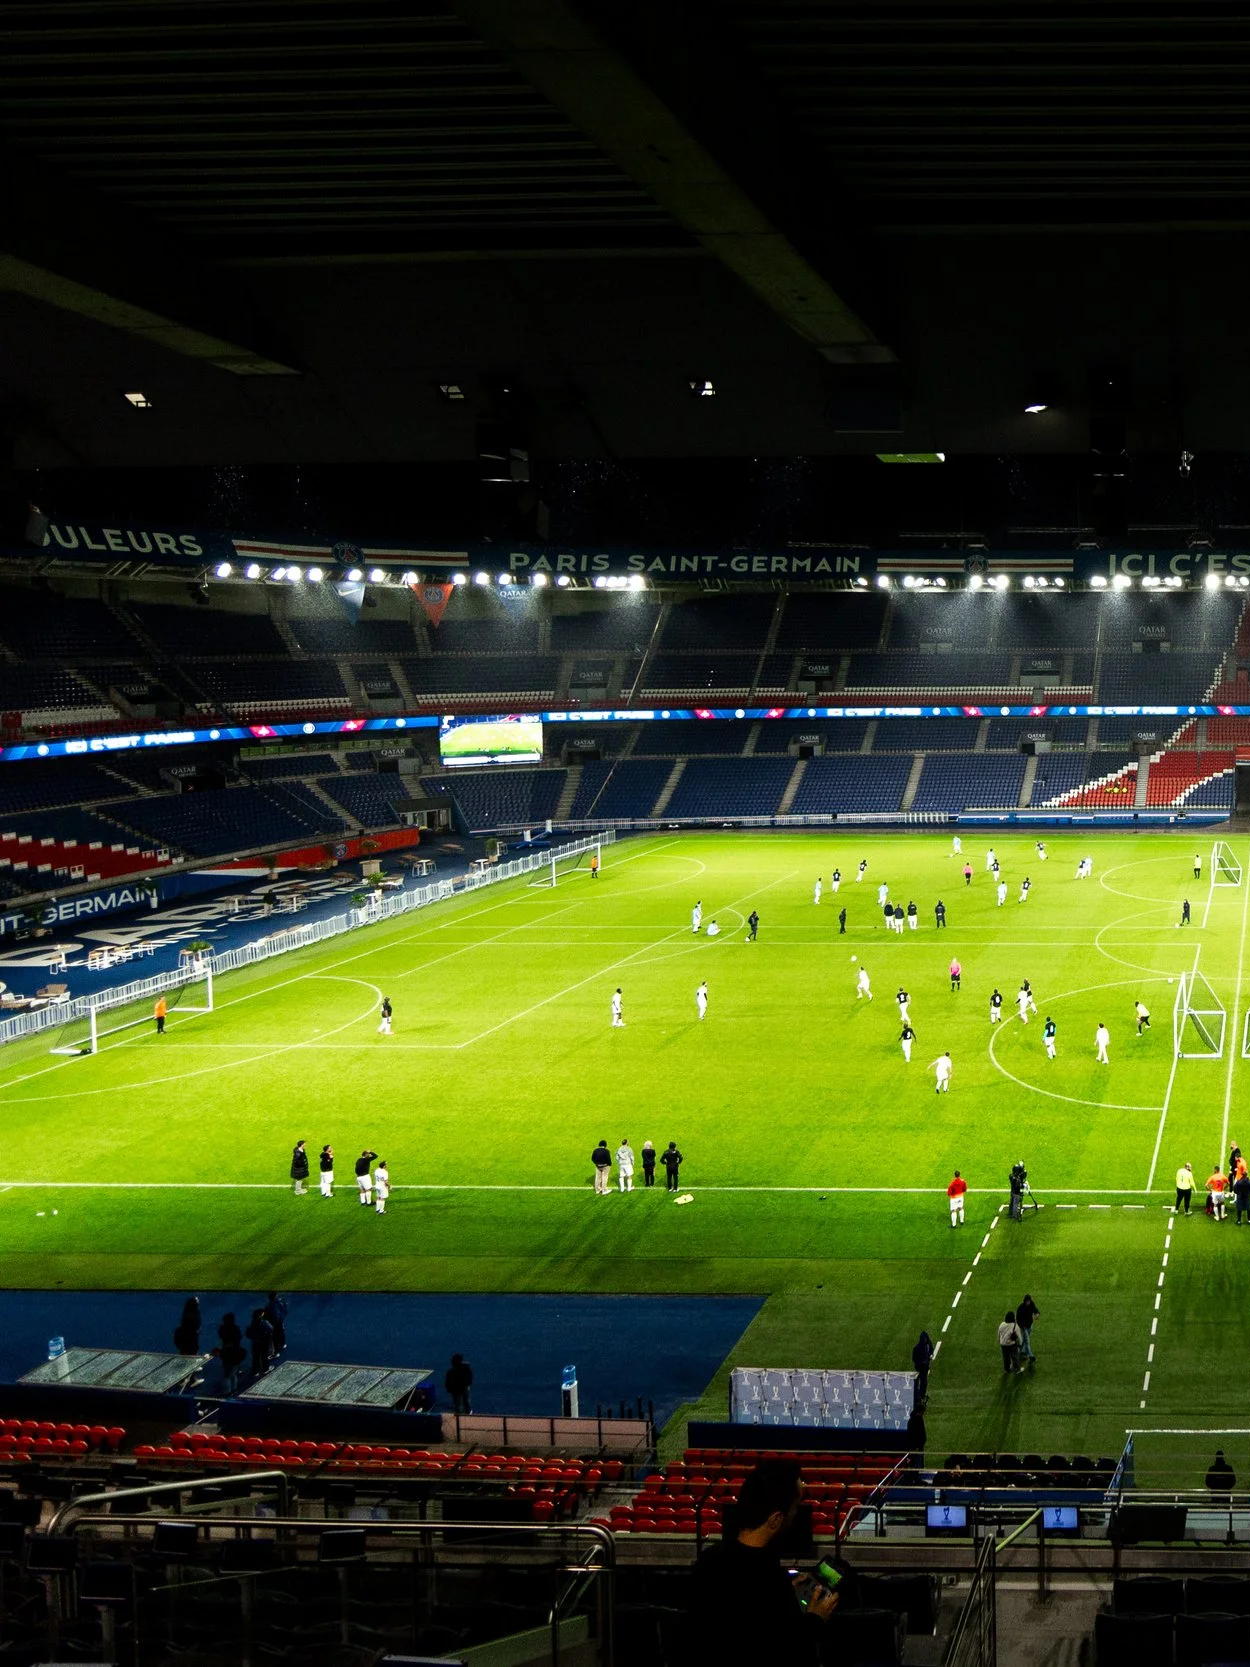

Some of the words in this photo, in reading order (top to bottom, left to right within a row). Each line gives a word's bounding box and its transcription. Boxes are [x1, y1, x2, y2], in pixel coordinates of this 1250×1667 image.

[43, 524, 203, 556] ULEURS
[509, 553, 611, 572] PARIS
[627, 555, 861, 573] SAINT-GERMAIN
[1109, 554, 1154, 576] ICI
[1138, 626, 1166, 635] QATAR
[171, 766, 196, 775] QATAR
[0, 888, 156, 935] T-GERMAIN
